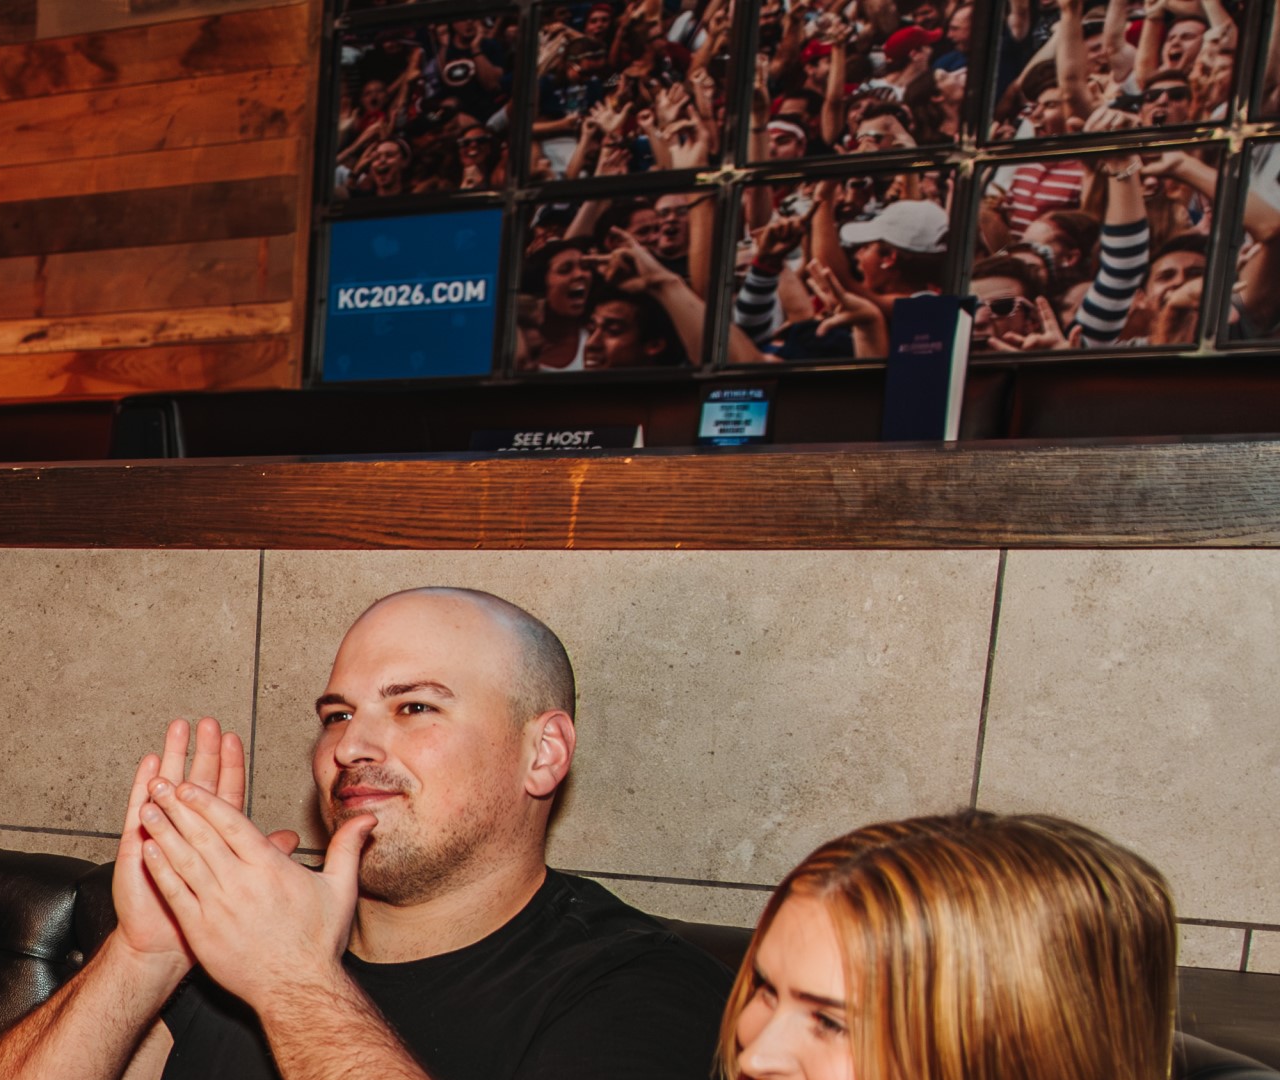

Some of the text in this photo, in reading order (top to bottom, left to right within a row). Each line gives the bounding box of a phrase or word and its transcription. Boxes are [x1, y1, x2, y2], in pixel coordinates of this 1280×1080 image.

[338, 279, 486, 309] KC2026.COM
[512, 431, 594, 446] SEE HOST
